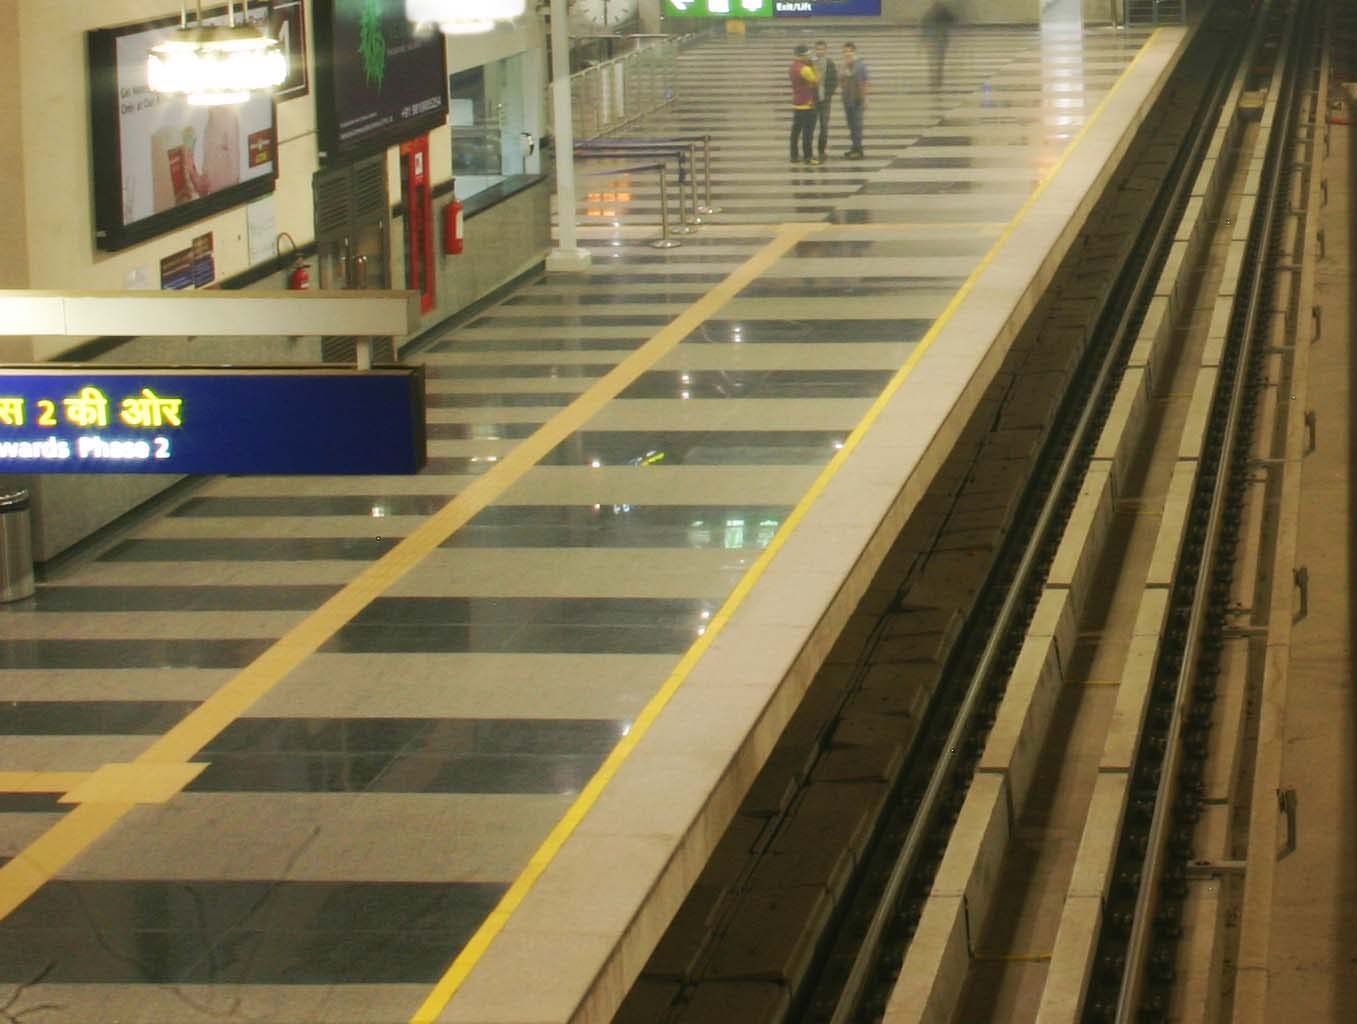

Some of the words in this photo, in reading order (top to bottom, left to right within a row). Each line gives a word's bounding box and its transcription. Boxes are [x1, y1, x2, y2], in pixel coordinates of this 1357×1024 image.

[37, 399, 57, 426] 2
[63, 386, 108, 426] की
[119, 387, 182, 426] ओर
[78, 436, 149, 459] Phase
[153, 436, 171, 459] 2
